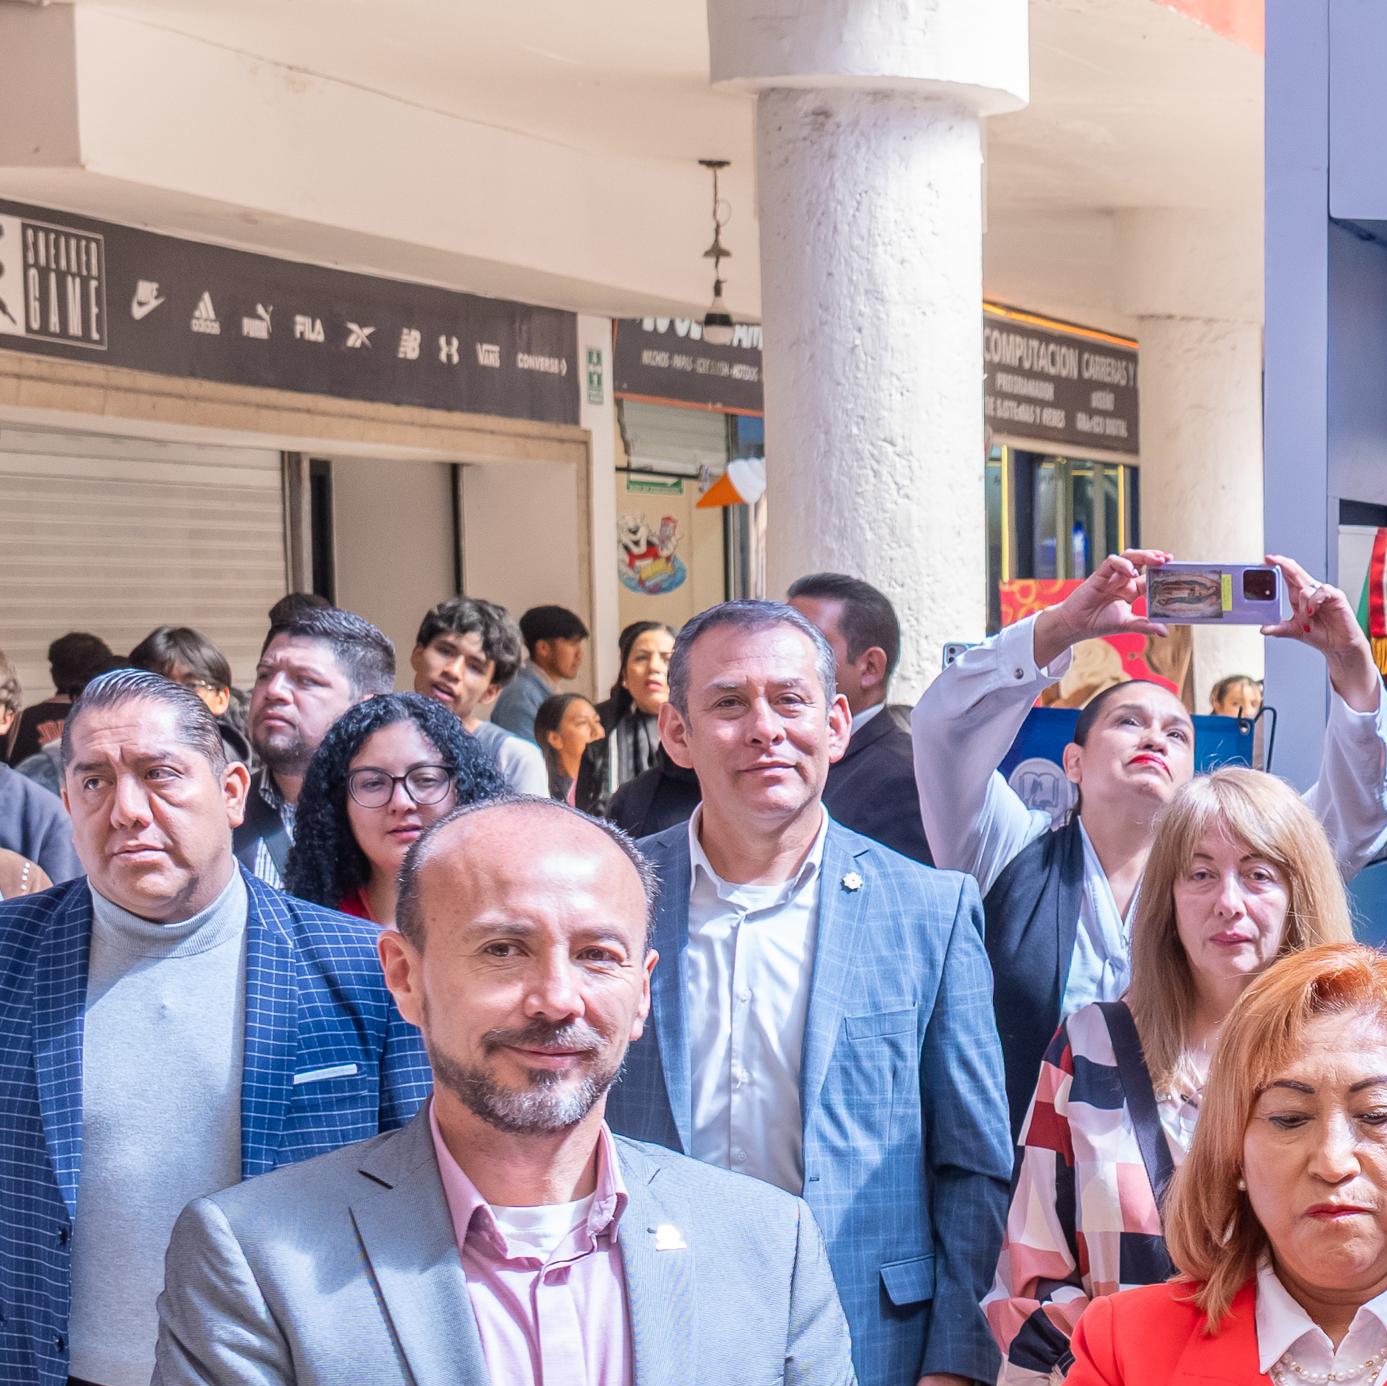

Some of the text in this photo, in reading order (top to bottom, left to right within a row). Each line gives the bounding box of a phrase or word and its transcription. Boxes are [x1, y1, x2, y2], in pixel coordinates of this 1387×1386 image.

[26, 228, 98, 277] SNEAKER
[28, 267, 100, 340] GAME
[294, 314, 325, 343] FILA
[1081, 352, 1128, 386] CARRERAS
